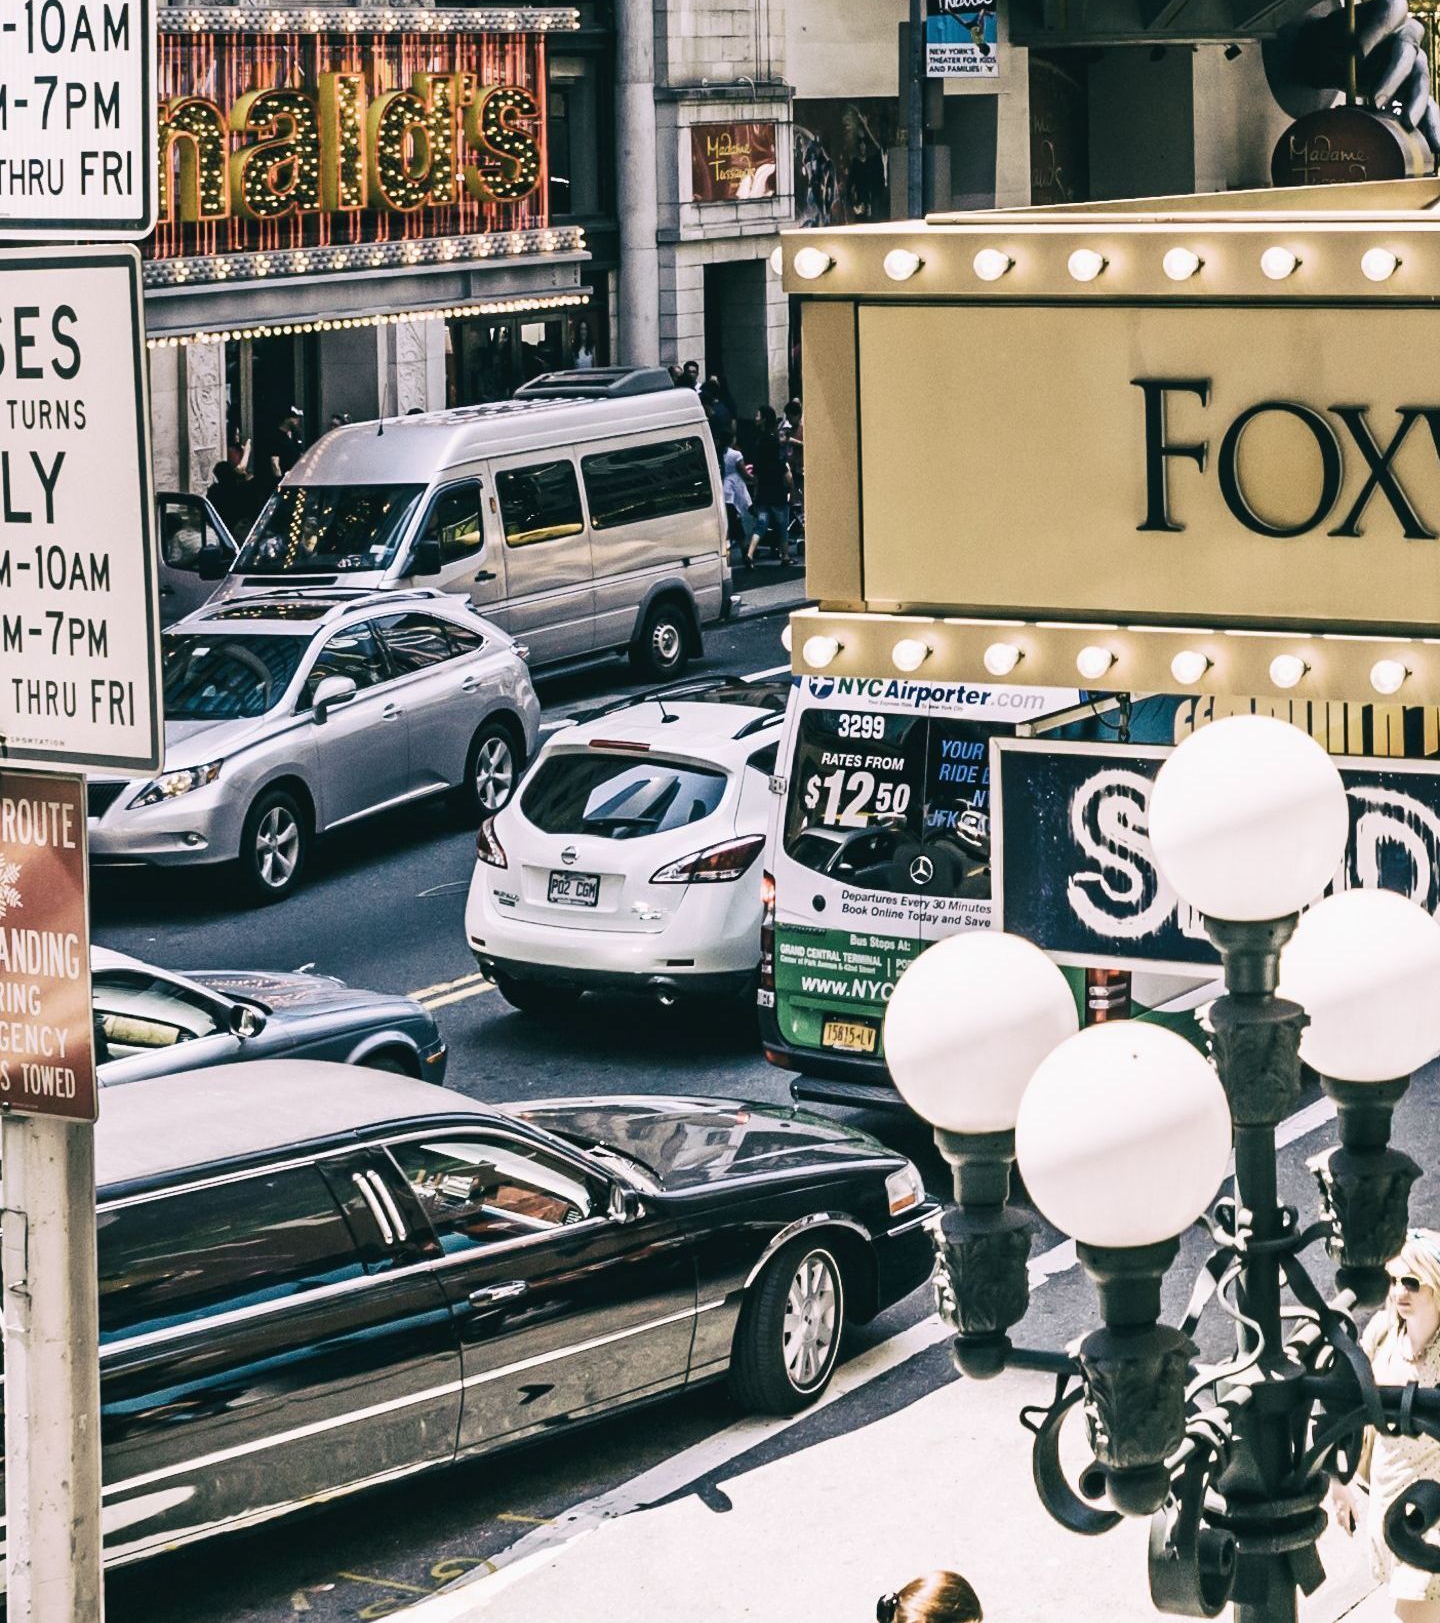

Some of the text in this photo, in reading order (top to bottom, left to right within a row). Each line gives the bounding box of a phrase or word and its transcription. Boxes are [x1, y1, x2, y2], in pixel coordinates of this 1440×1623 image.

[707, 132, 753, 158] Madame
[1290, 135, 1370, 165] Madame
[80, 151, 133, 196] FRI
[7, 400, 86, 431] TURNS
[837, 677, 883, 697] NYC
[12, 678, 77, 718] THRU
[91, 681, 135, 726] FRI
[837, 713, 885, 740] 3299
[821, 752, 905, 771] RATES FROM
[941, 740, 985, 760] YOUR
[939, 764, 977, 784] RIDE
[2, 798, 77, 849] ROUTE
[841, 890, 992, 914] Departures Every 30 Minutes
[842, 903, 992, 928] Book Online Today and Save
[850, 933, 895, 950] Bus Stops
[780, 943, 806, 957] GRAND
[806, 947, 841, 962] CENTRAL
[843, 951, 882, 967] TERMINAL
[21, 1062, 77, 1099] TOWED
